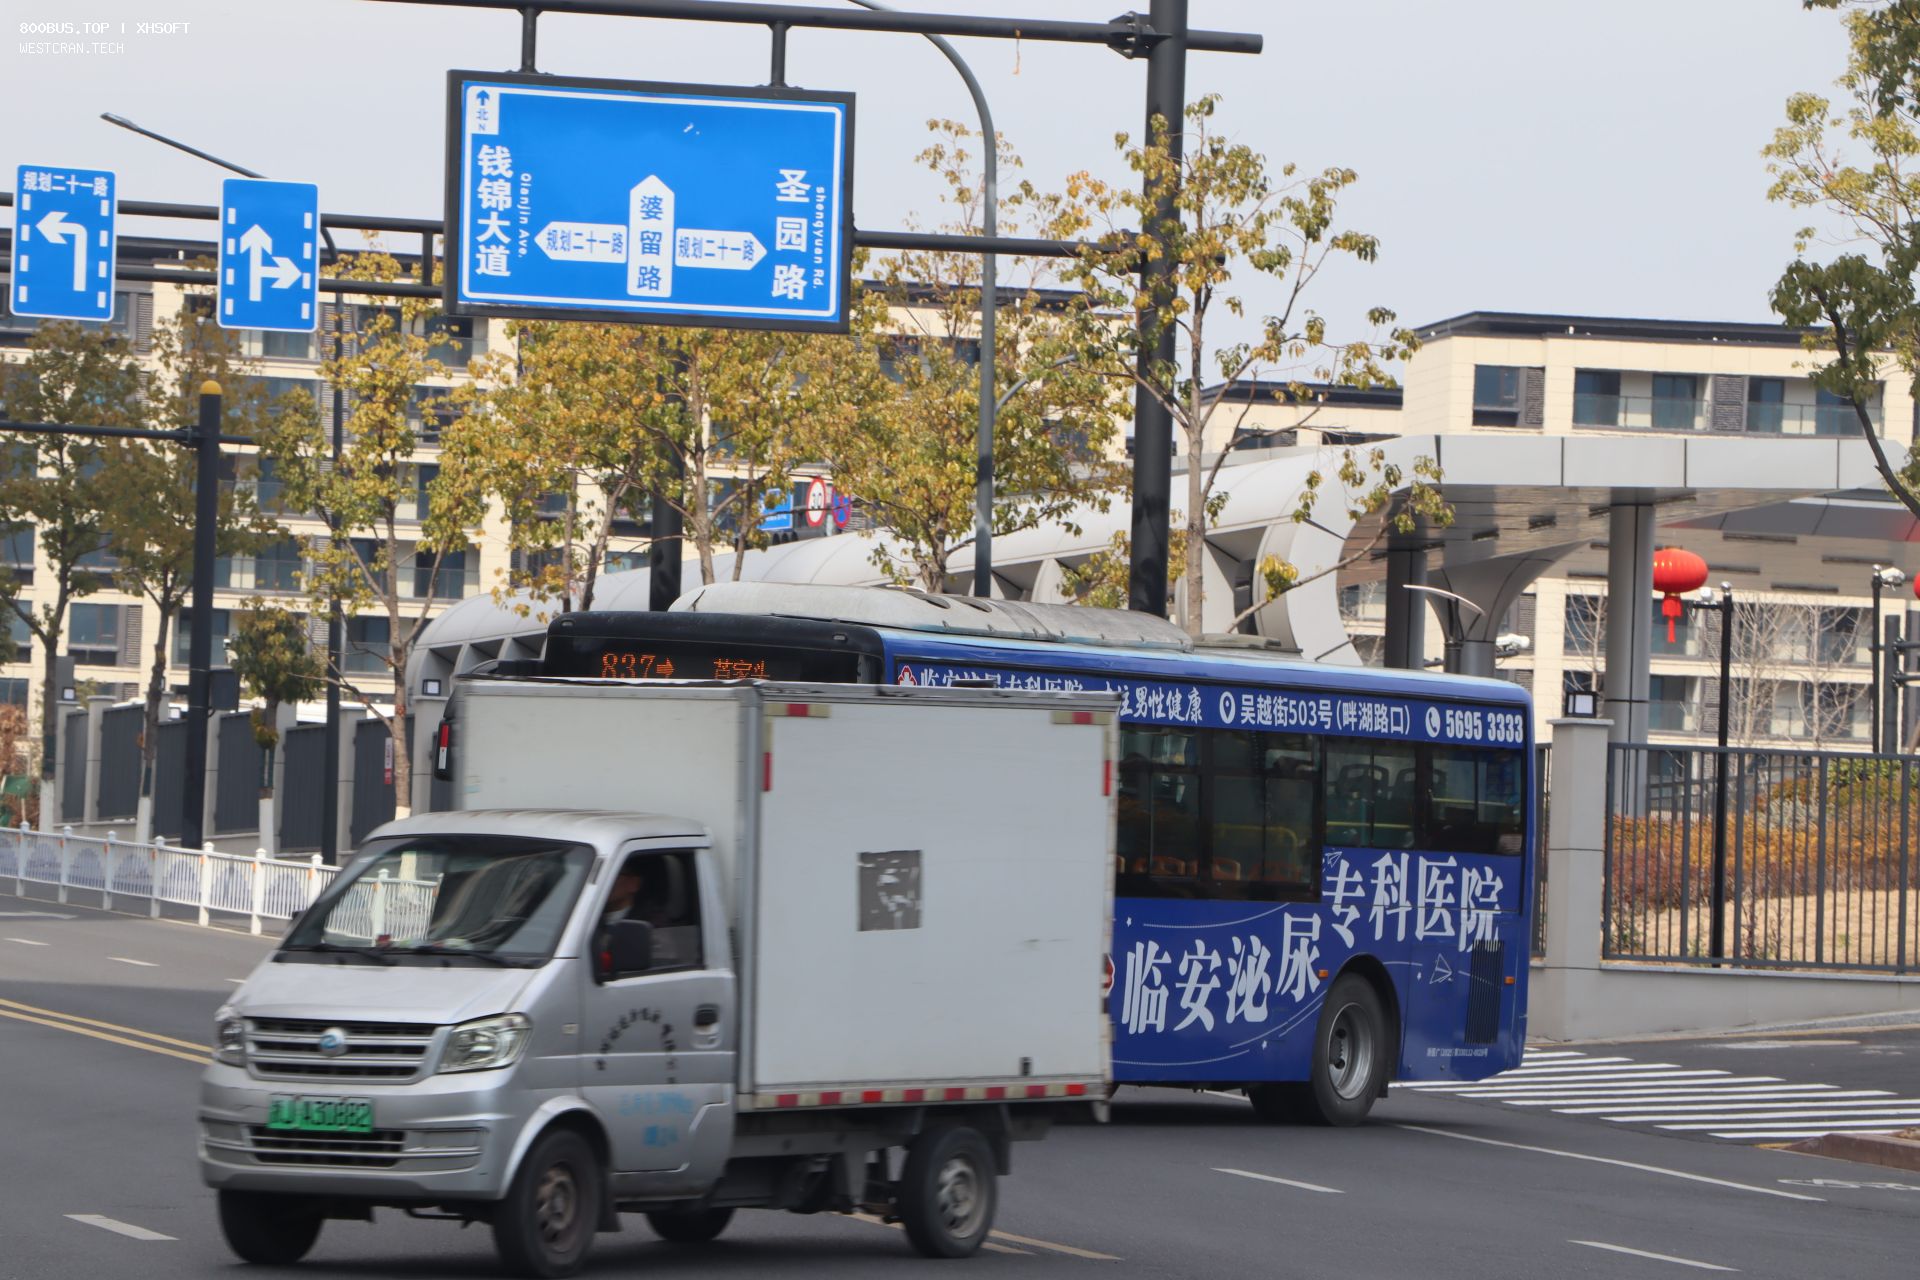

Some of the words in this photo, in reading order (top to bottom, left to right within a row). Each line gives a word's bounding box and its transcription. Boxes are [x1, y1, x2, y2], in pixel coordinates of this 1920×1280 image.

[476, 108, 488, 120] 北
[23, 171, 108, 197] 规划二十一路
[517, 172, 532, 224] Qianjin
[475, 144, 513, 277] 钱锦大道
[771, 168, 812, 300] 圣园路
[812, 186, 826, 264] shengyuan
[518, 229, 530, 257] Ave.
[546, 229, 623, 254] 规划二十一路
[637, 194, 664, 292] 婆留路
[678, 236, 754, 261] 规划二十一路
[813, 269, 825, 288] Rd.
[601, 653, 656, 679] 837
[1445, 708, 1483, 741] 5695
[1487, 712, 1523, 743] 3333
